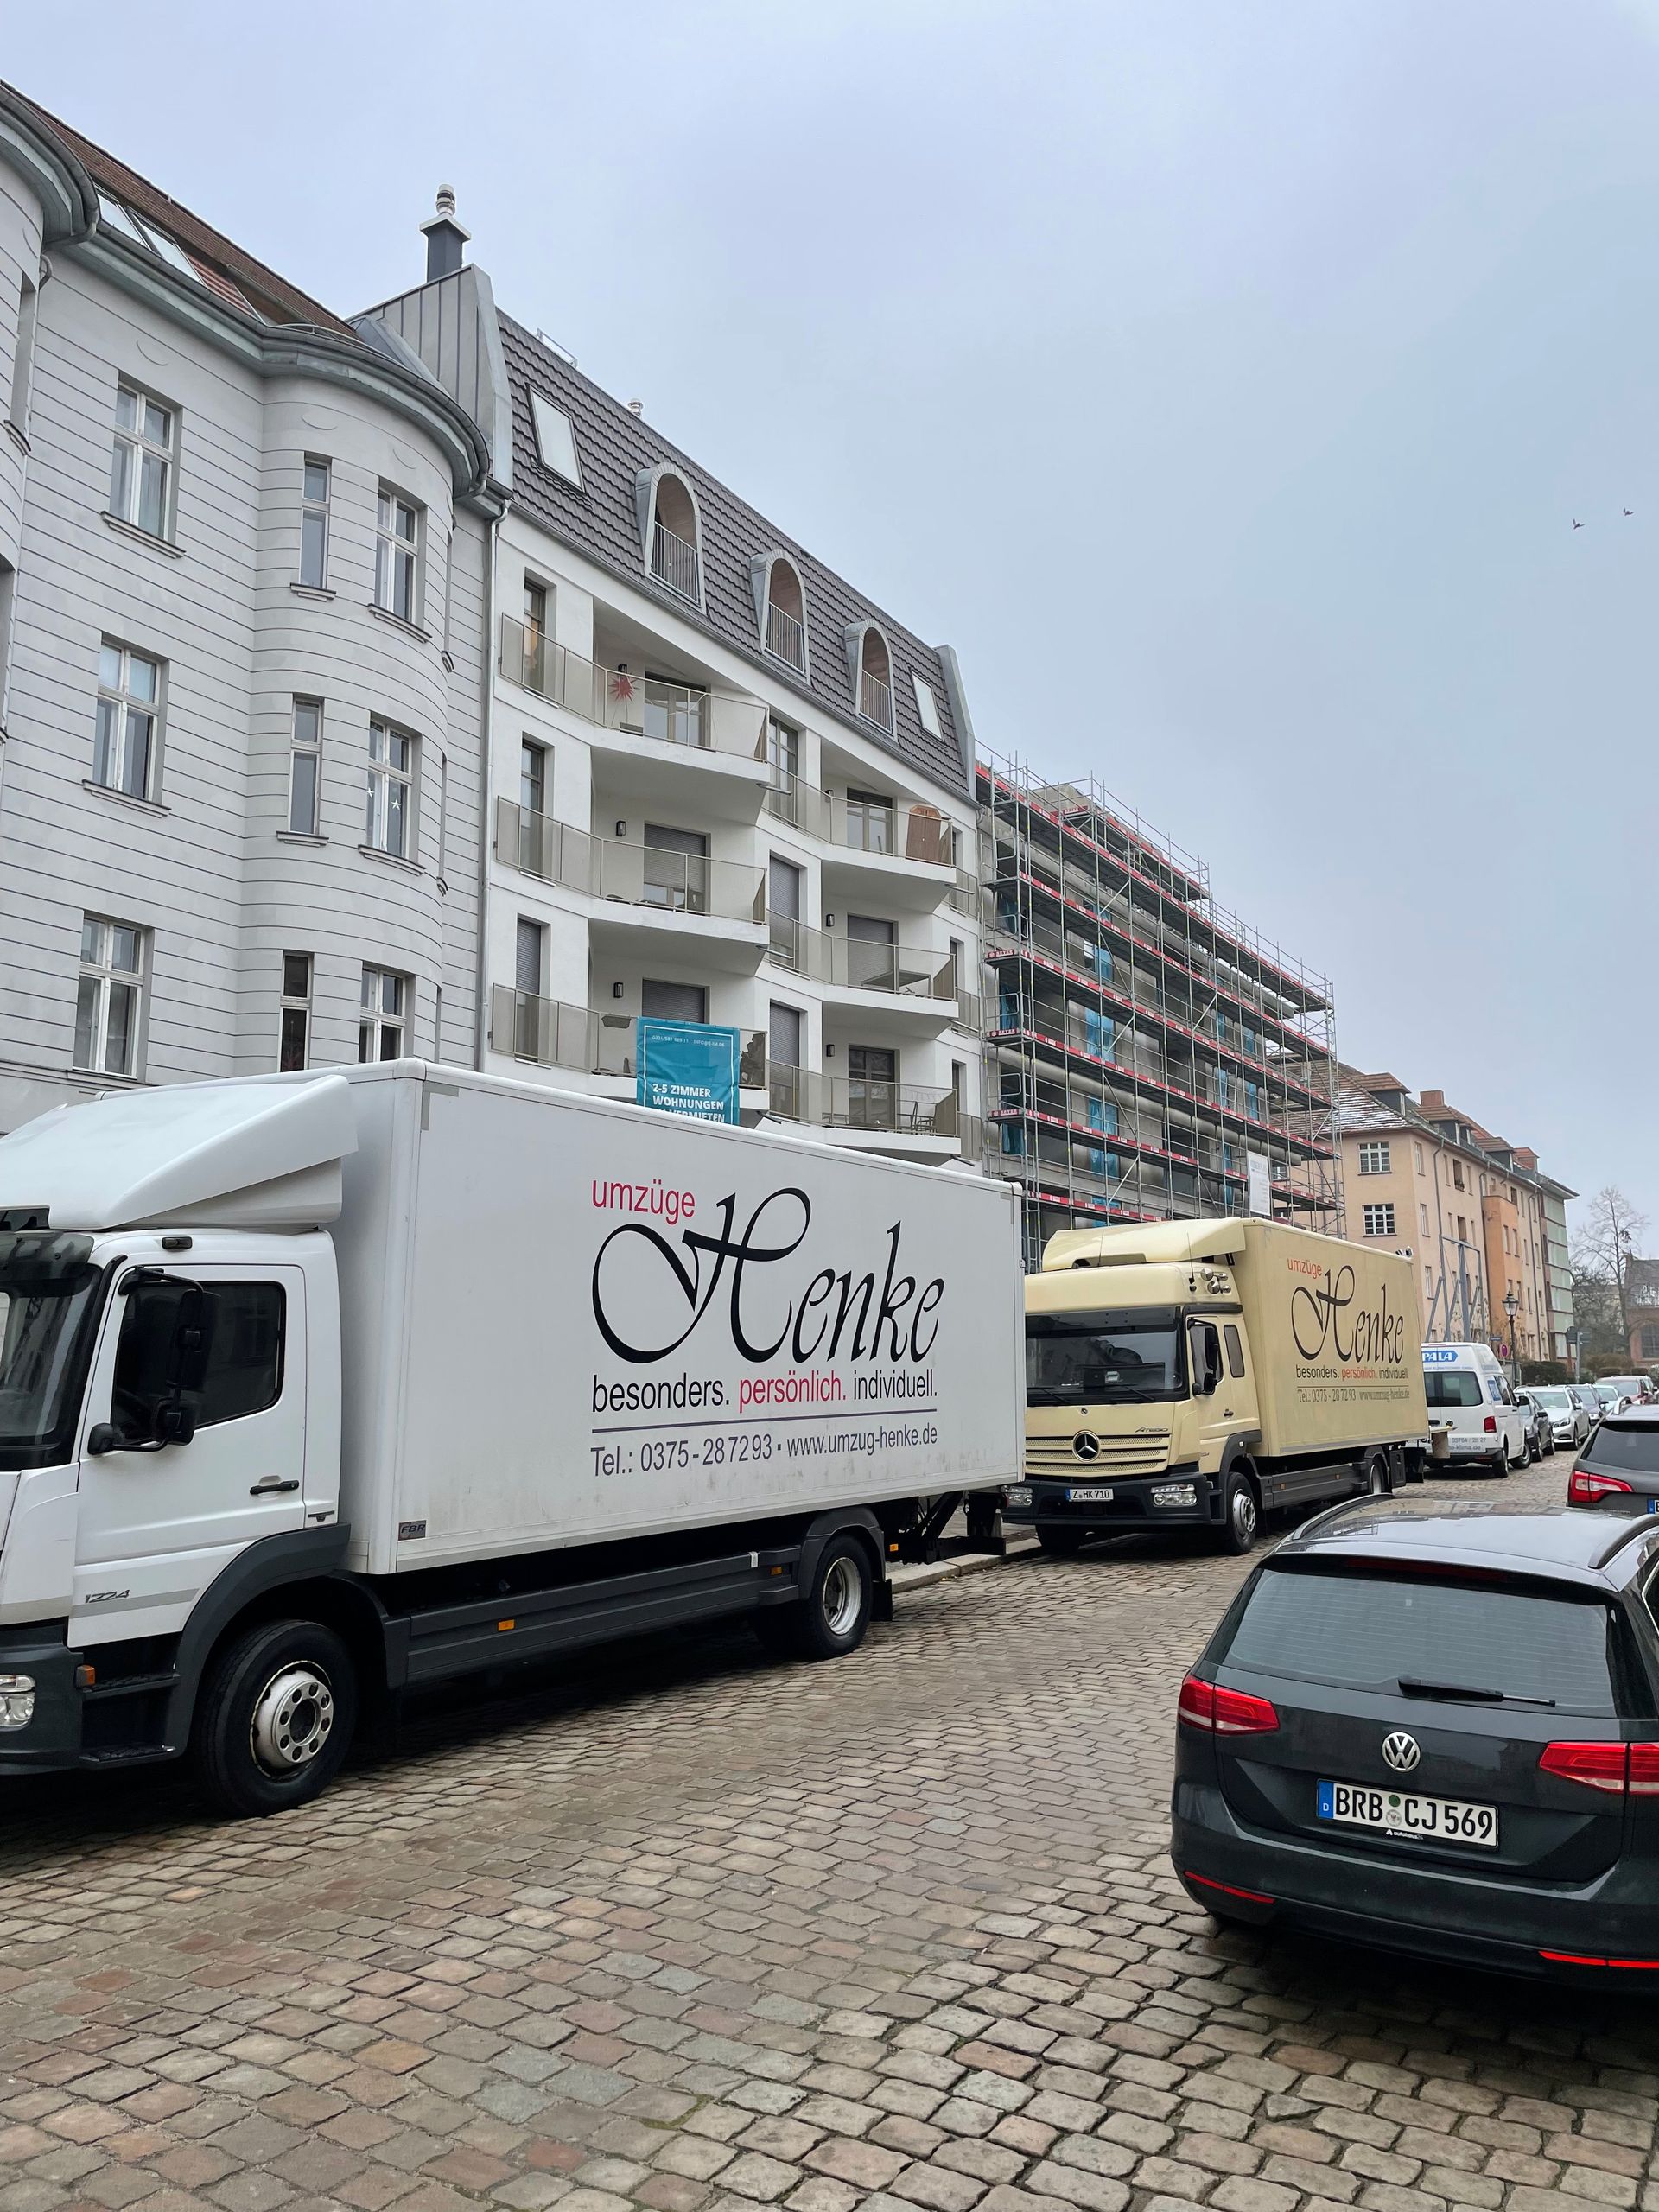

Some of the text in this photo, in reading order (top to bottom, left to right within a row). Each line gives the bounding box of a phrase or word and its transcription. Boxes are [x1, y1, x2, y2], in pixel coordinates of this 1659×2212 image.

[652, 1084, 711, 1098] 2-5 ZIMMER
[652, 1095, 724, 1110] WOHNUNGEN
[593, 1179, 696, 1225] umzüge
[592, 1187, 944, 1363] Henke
[1287, 1258, 1322, 1279] umzüge
[1291, 1265, 1403, 1364] Henke
[1296, 1364, 1340, 1378] besonders.
[592, 1369, 938, 1414] besonders. persönlich. individuell.
[590, 1446, 632, 1477] Tel.:
[786, 1422, 938, 1457] www.umzug-henke.de
[1094, 1490, 1109, 1498] 710
[401, 1523, 426, 1534] FBR
[86, 1590, 130, 1604] 1224
[1323, 1787, 1492, 1840] D BRB CJ 569
